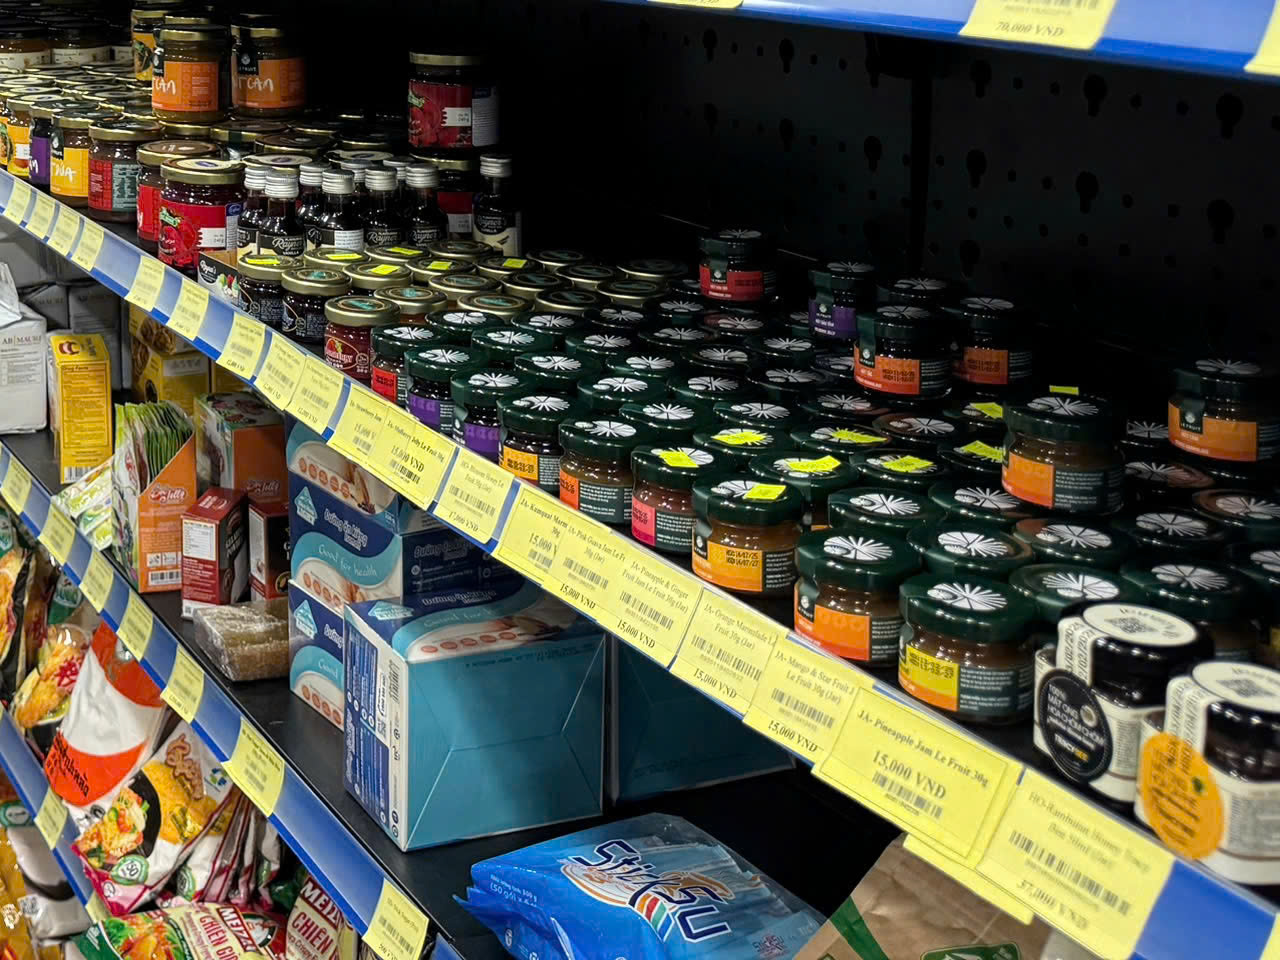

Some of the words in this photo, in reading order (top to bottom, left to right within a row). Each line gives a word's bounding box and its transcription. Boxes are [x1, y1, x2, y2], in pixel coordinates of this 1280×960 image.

[1034, 24, 1064, 38] VND
[616, 618, 638, 639] 15,000
[638, 631, 656, 650] VND
[693, 666, 718, 689] 15,000
[717, 679, 738, 700] VND
[767, 719, 796, 743] 15,000
[796, 734, 818, 754] VND
[874, 715, 915, 748] Pineapple
[914, 735, 934, 758] Jam
[946, 753, 972, 778] Fruit
[872, 750, 913, 782] 15,000
[914, 767, 948, 801] VND
